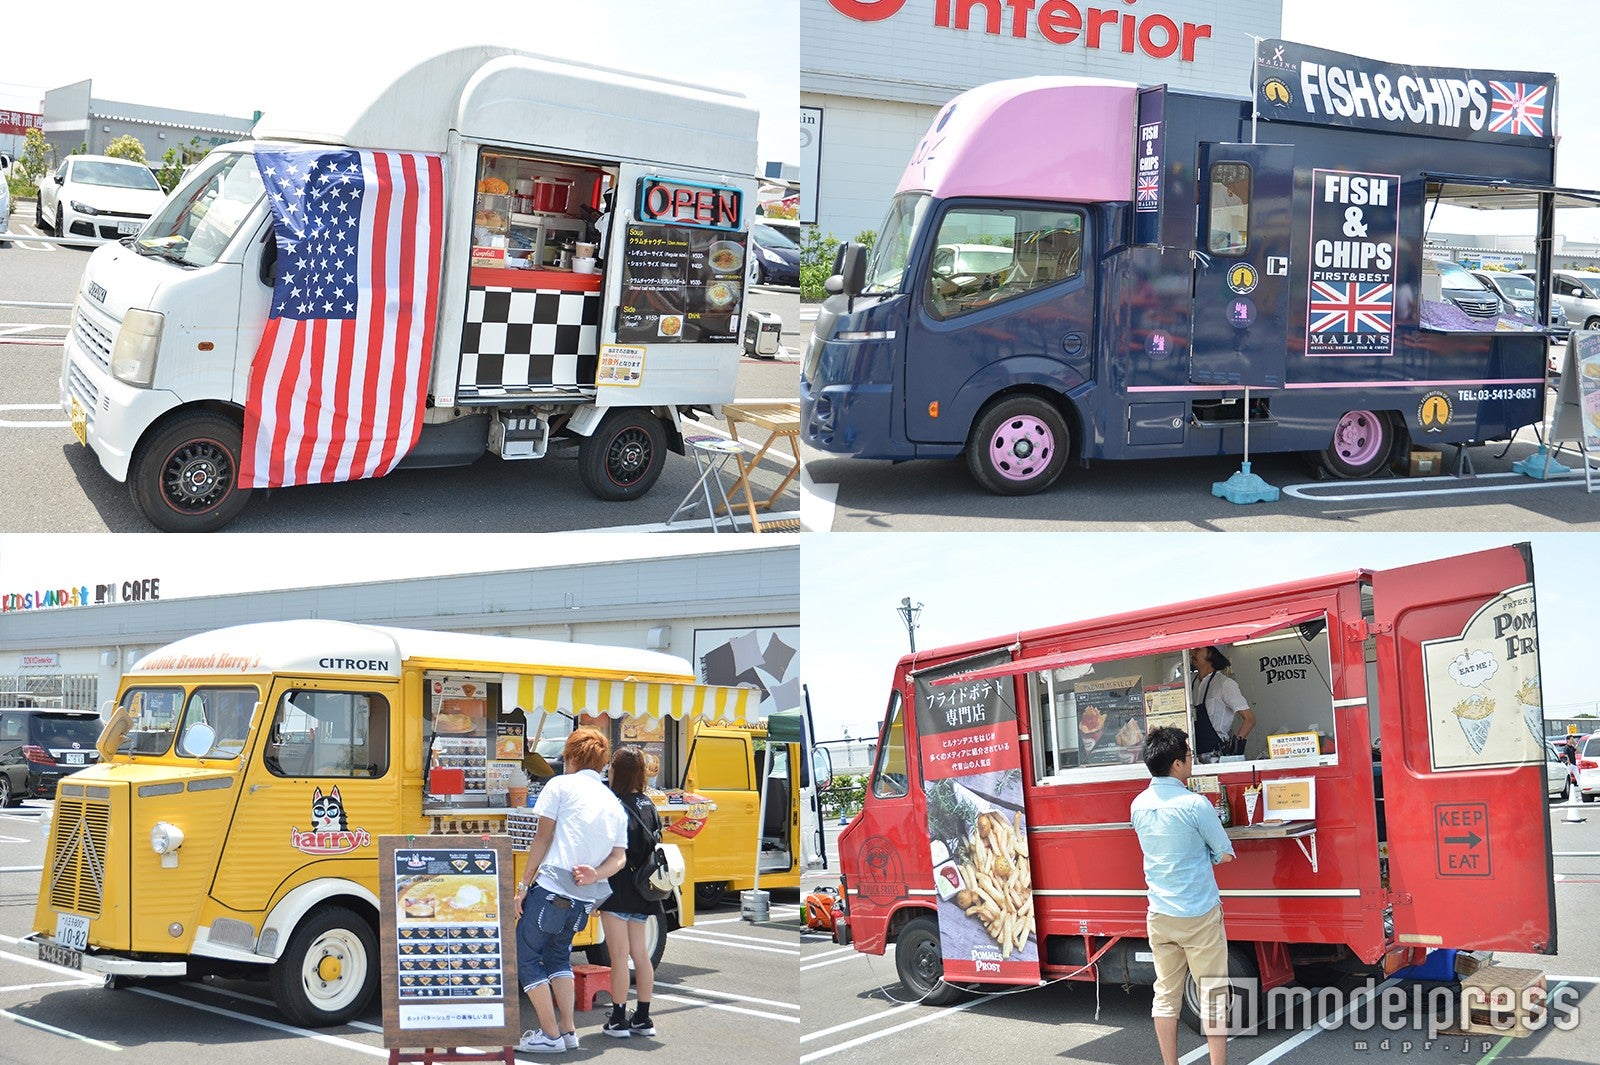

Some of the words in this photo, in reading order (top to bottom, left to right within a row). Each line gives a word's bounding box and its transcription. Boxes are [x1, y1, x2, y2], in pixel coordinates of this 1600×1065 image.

[1142, 125, 1159, 141] FISH
[1146, 140, 1154, 156] &
[1140, 156, 1159, 171] CHIPS
[1324, 175, 1388, 206] FISH
[647, 184, 738, 224] OPEN
[1342, 206, 1368, 238] &
[629, 228, 644, 237] Soup
[629, 238, 666, 246] クラムチャウダー
[1314, 240, 1392, 270] CHIPS
[1310, 334, 1390, 344] MALINS
[122, 578, 160, 602] CAFE
[2, 592, 33, 612] KIDS
[35, 589, 70, 608] LAND
[176, 653, 216, 670] Branch
[318, 658, 388, 672] CITROEN
[1259, 654, 1312, 672] POMMES
[1266, 670, 1306, 685] PROST
[1459, 666, 1475, 676] EAT
[926, 680, 1003, 710] フライドポテト
[946, 704, 986, 726] 専門店
[930, 742, 1010, 762] 多くのメディアに紹介されている
[1440, 811, 1483, 827] KEEP
[291, 826, 370, 855] harry's
[1448, 854, 1480, 870] EAT
[970, 950, 1004, 962] POMMES
[975, 960, 1001, 972] PROST
